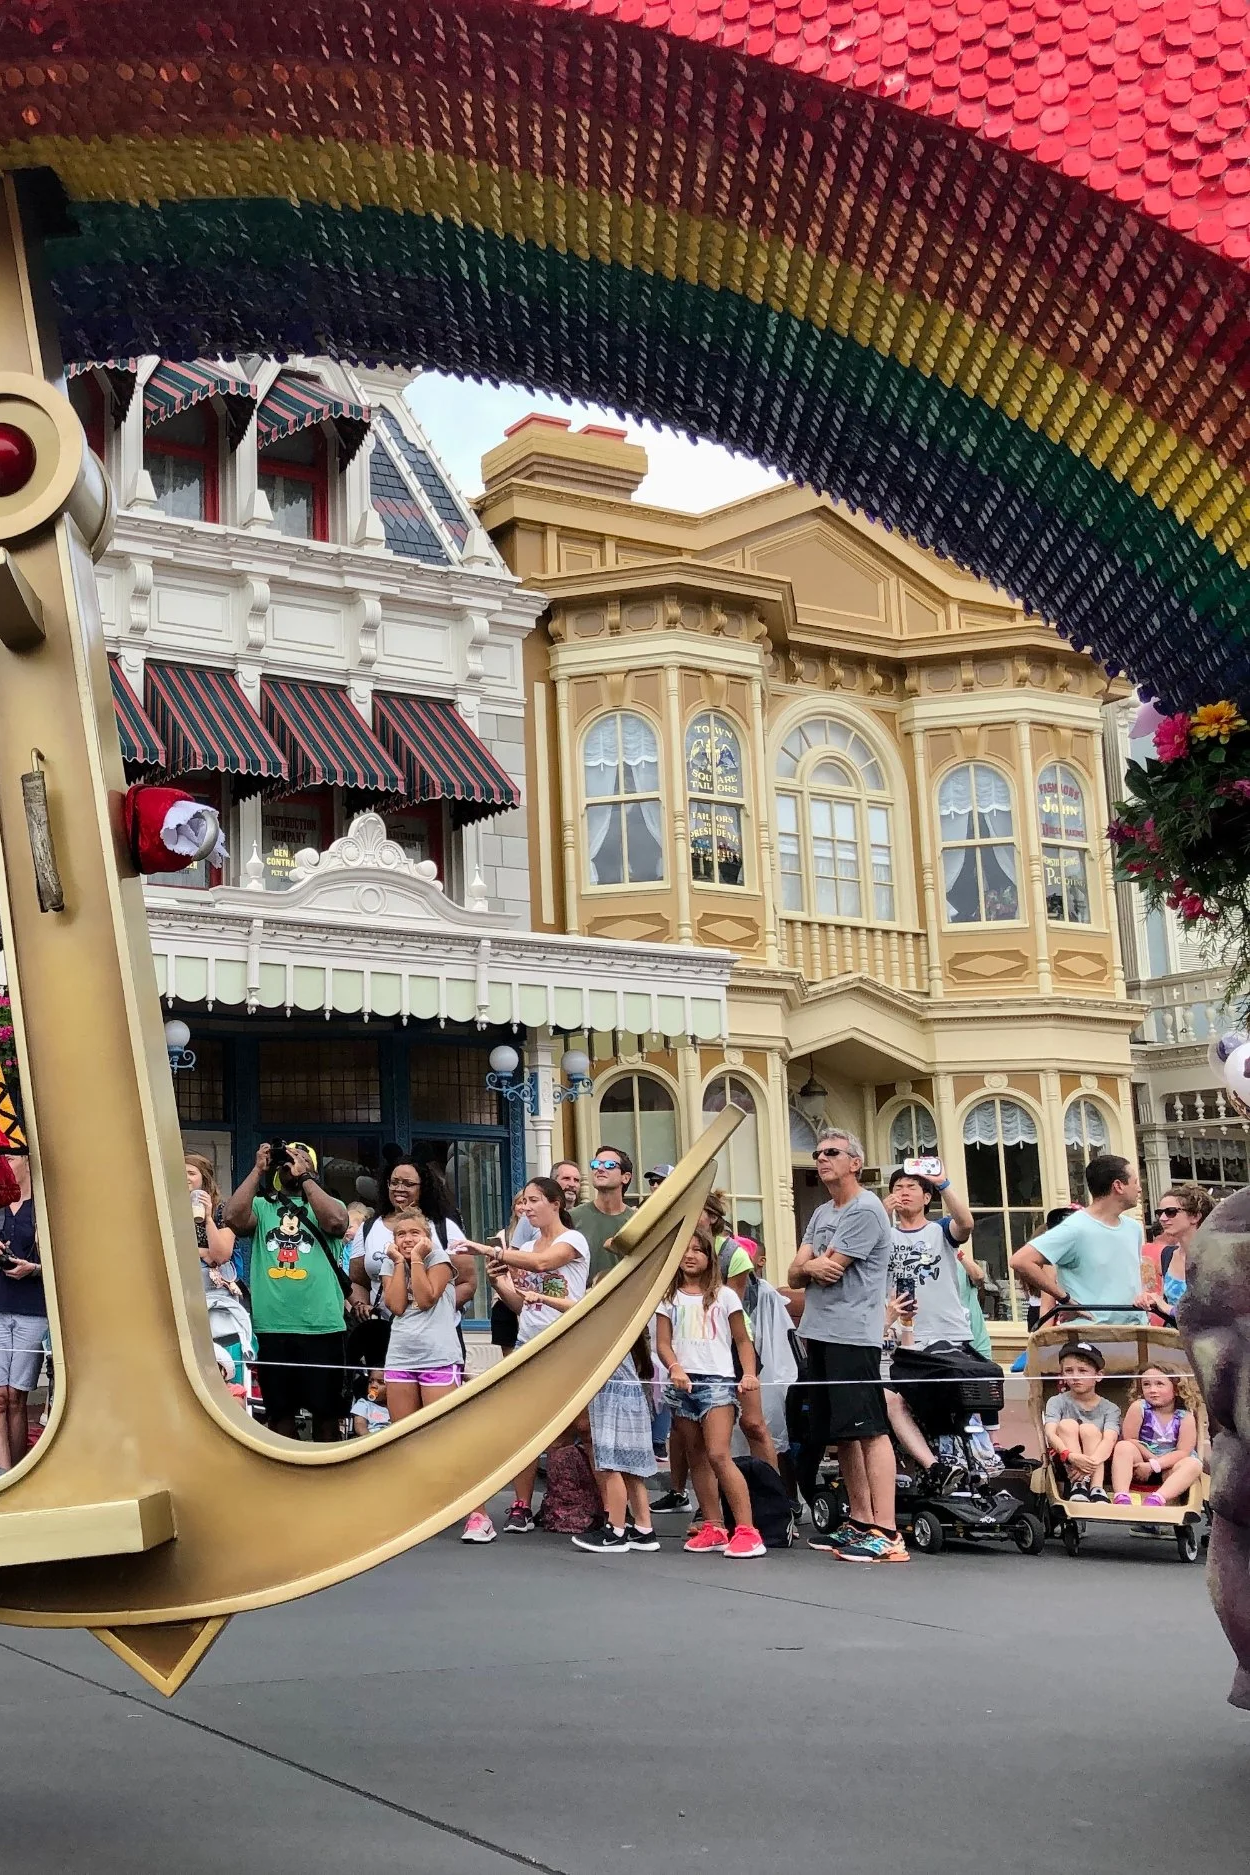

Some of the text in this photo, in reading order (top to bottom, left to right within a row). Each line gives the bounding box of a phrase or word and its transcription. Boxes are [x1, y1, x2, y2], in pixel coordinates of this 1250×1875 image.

[694, 724, 733, 739] TOWN
[691, 768, 738, 784] SQUARE
[690, 780, 738, 794] TAILORS
[263, 814, 317, 831] ONSTRUCTION
[691, 811, 734, 824] TAILORS
[889, 1252, 909, 1262] UCKY
